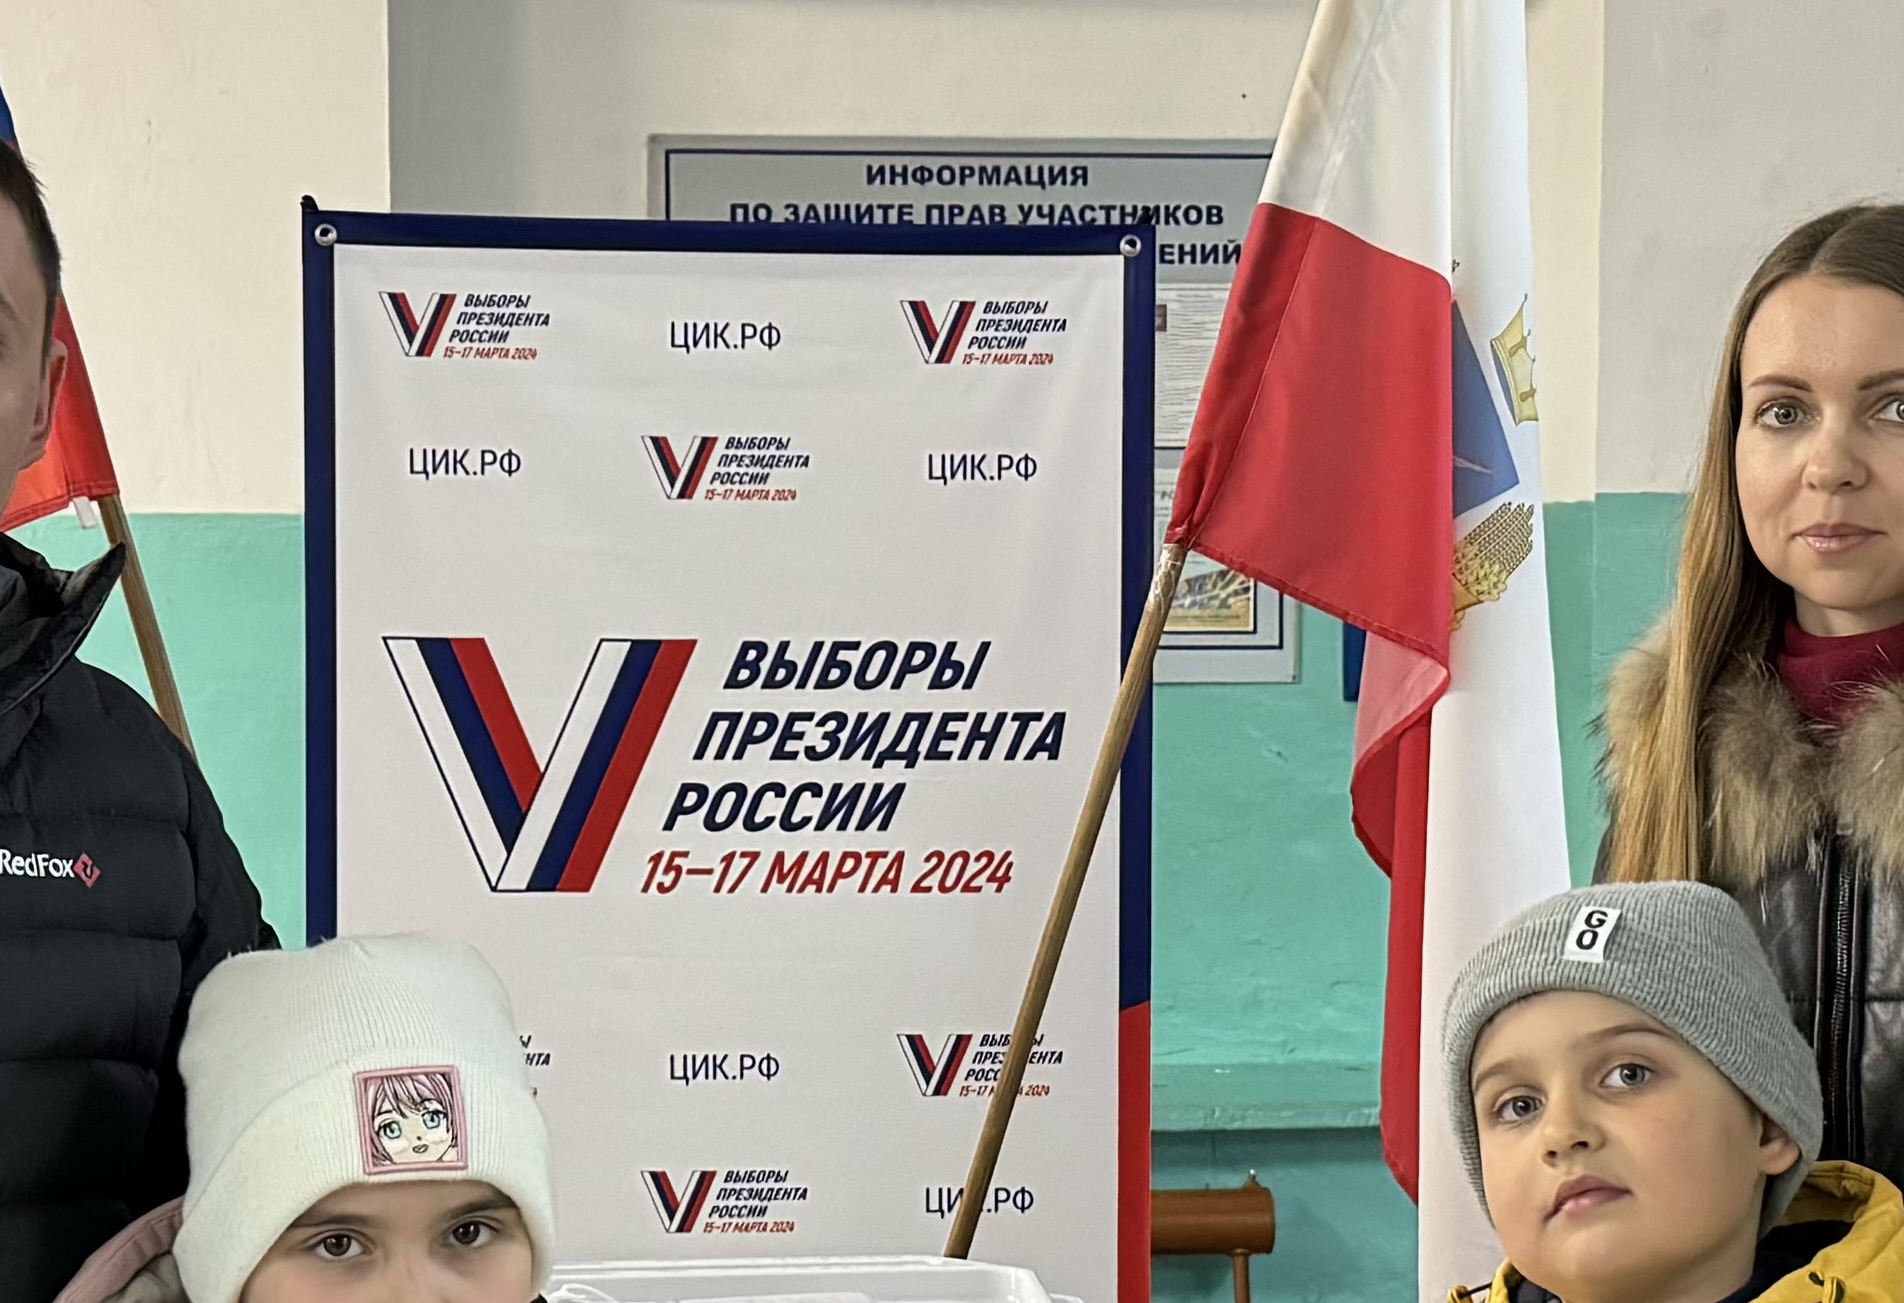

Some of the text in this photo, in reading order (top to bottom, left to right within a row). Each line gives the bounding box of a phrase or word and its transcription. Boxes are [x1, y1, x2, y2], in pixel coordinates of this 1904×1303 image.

[866, 164, 1089, 190] ИНФОРМАЦИЯ
[730, 203, 1224, 226] ПО ЗАЩИТЕ ПРАВ УЧАСТНИКОВ
[1158, 239, 1242, 265] ЕНИЙ
[463, 293, 532, 309] ВЫБОРЫ
[982, 300, 1049, 315] ВЫБОРЫ
[456, 311, 551, 329] ПРЕЗИДЕНТА
[975, 318, 1067, 334] ПРЕЗИДЕНТА
[448, 328, 510, 344] РОССИИ
[670, 320, 781, 355] ЦИК.РФ
[967, 335, 1028, 350] РОССИИ
[473, 346, 511, 359] МАРТА
[510, 347, 538, 361] 2024
[991, 352, 1028, 365] МАРТА
[1028, 352, 1054, 366] 2024
[724, 436, 791, 451] ВЫБОРЫ
[409, 447, 522, 481] ЦИК.РФ
[717, 453, 810, 470] ПРЕЗИДЕНТА
[928, 452, 1038, 487] ЦИК.РФ
[709, 471, 771, 486] РОССИИ
[734, 488, 771, 501] МАРТА
[770, 488, 797, 502] 2024
[722, 640, 992, 691] ВЫБОРЫ
[692, 710, 1067, 770] ПРЕЗИДЕНТА
[661, 781, 907, 833] РОССИИ
[761, 850, 906, 894] МАРТА
[909, 849, 1014, 894] 2024
[978, 1033, 1045, 1048] ВЫБЫ
[669, 1052, 780, 1087] ЦИК.РФ
[723, 1169, 790, 1184] ВЫБОРЫ
[715, 1186, 808, 1203] ПРЕЗИДЕНТА
[925, 1185, 1035, 1219] ЦИ.РФ
[708, 1204, 769, 1219] РОССИИ
[732, 1221, 769, 1234] МАРТА
[769, 1220, 795, 1234] 2024
